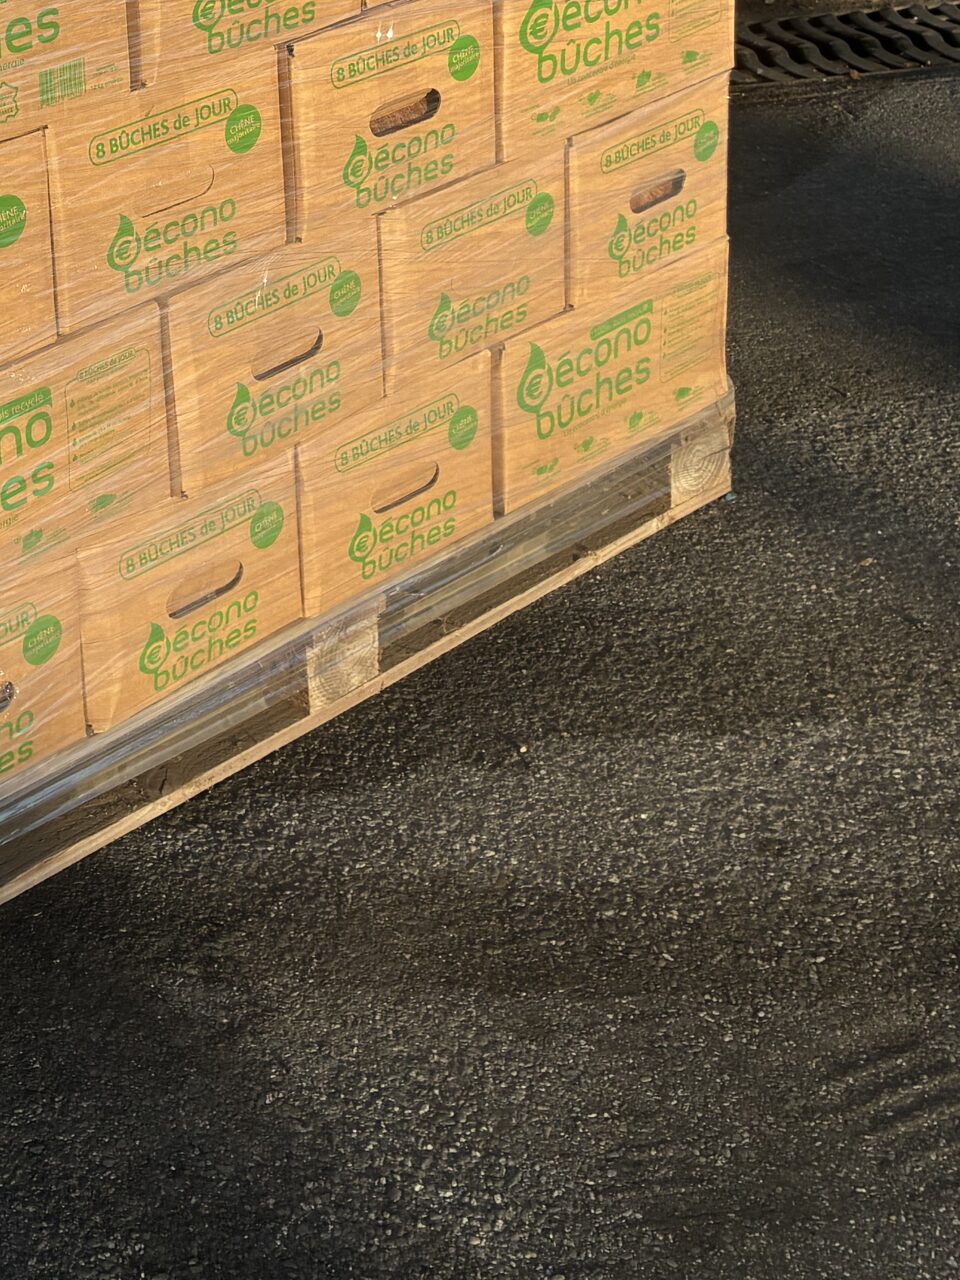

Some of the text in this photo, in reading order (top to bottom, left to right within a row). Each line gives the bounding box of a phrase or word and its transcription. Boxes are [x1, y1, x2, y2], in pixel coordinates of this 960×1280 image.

[207, 0, 316, 55] bûches
[336, 26, 454, 82] 8 BÛCHES de JOUR
[537, 11, 661, 84] bûches
[96, 96, 231, 159] 8 BÛCHES de JOUR
[374, 123, 456, 171] écono
[605, 154, 613, 168] 8
[614, 132, 657, 165] BÛCHES
[659, 130, 672, 144] de
[674, 116, 701, 141] JOUR
[356, 153, 454, 209] bûches
[143, 198, 237, 252] écono
[426, 230, 433, 244] 8
[436, 206, 486, 242] BÛCHES
[486, 203, 500, 219] de
[502, 188, 533, 216] JOUR
[632, 198, 698, 245] écono
[123, 230, 238, 294] bûches
[618, 225, 697, 278] bûches
[214, 263, 336, 331] 8 BÛCHES de JOUR
[452, 275, 530, 323] écono
[438, 302, 528, 361] bûches
[555, 318, 652, 388] écono
[258, 359, 341, 417] écono
[535, 357, 651, 440] bûches
[240, 390, 341, 457] bûches
[339, 400, 455, 467] 8 BÛCHES de JOUR
[125, 497, 257, 574] 8 BÛCHES de JOUR
[378, 489, 457, 546] écono
[360, 516, 456, 580] bûches
[172, 590, 258, 654] écono
[152, 618, 258, 693] bûches
